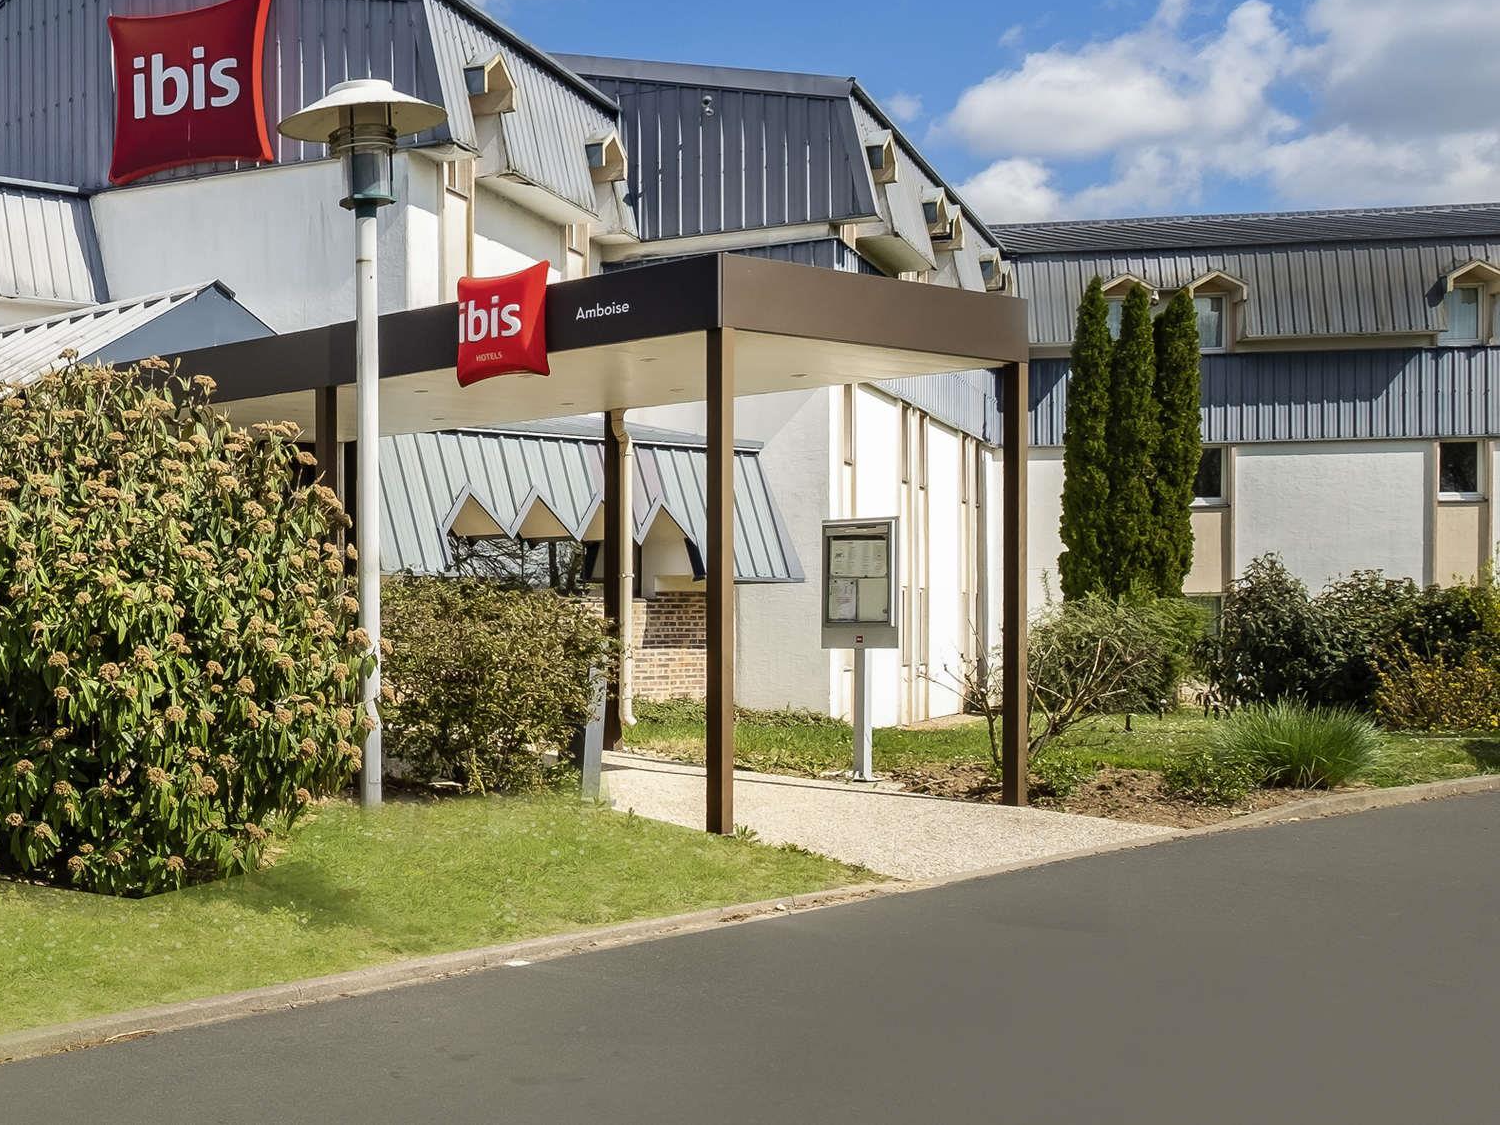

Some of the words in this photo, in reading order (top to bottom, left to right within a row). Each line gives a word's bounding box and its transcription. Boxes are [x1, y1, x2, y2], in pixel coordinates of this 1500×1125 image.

[133, 45, 240, 120] ibis
[458, 295, 522, 344] ibis
[576, 301, 630, 321] Amboise
[475, 351, 503, 362] HOTELS
